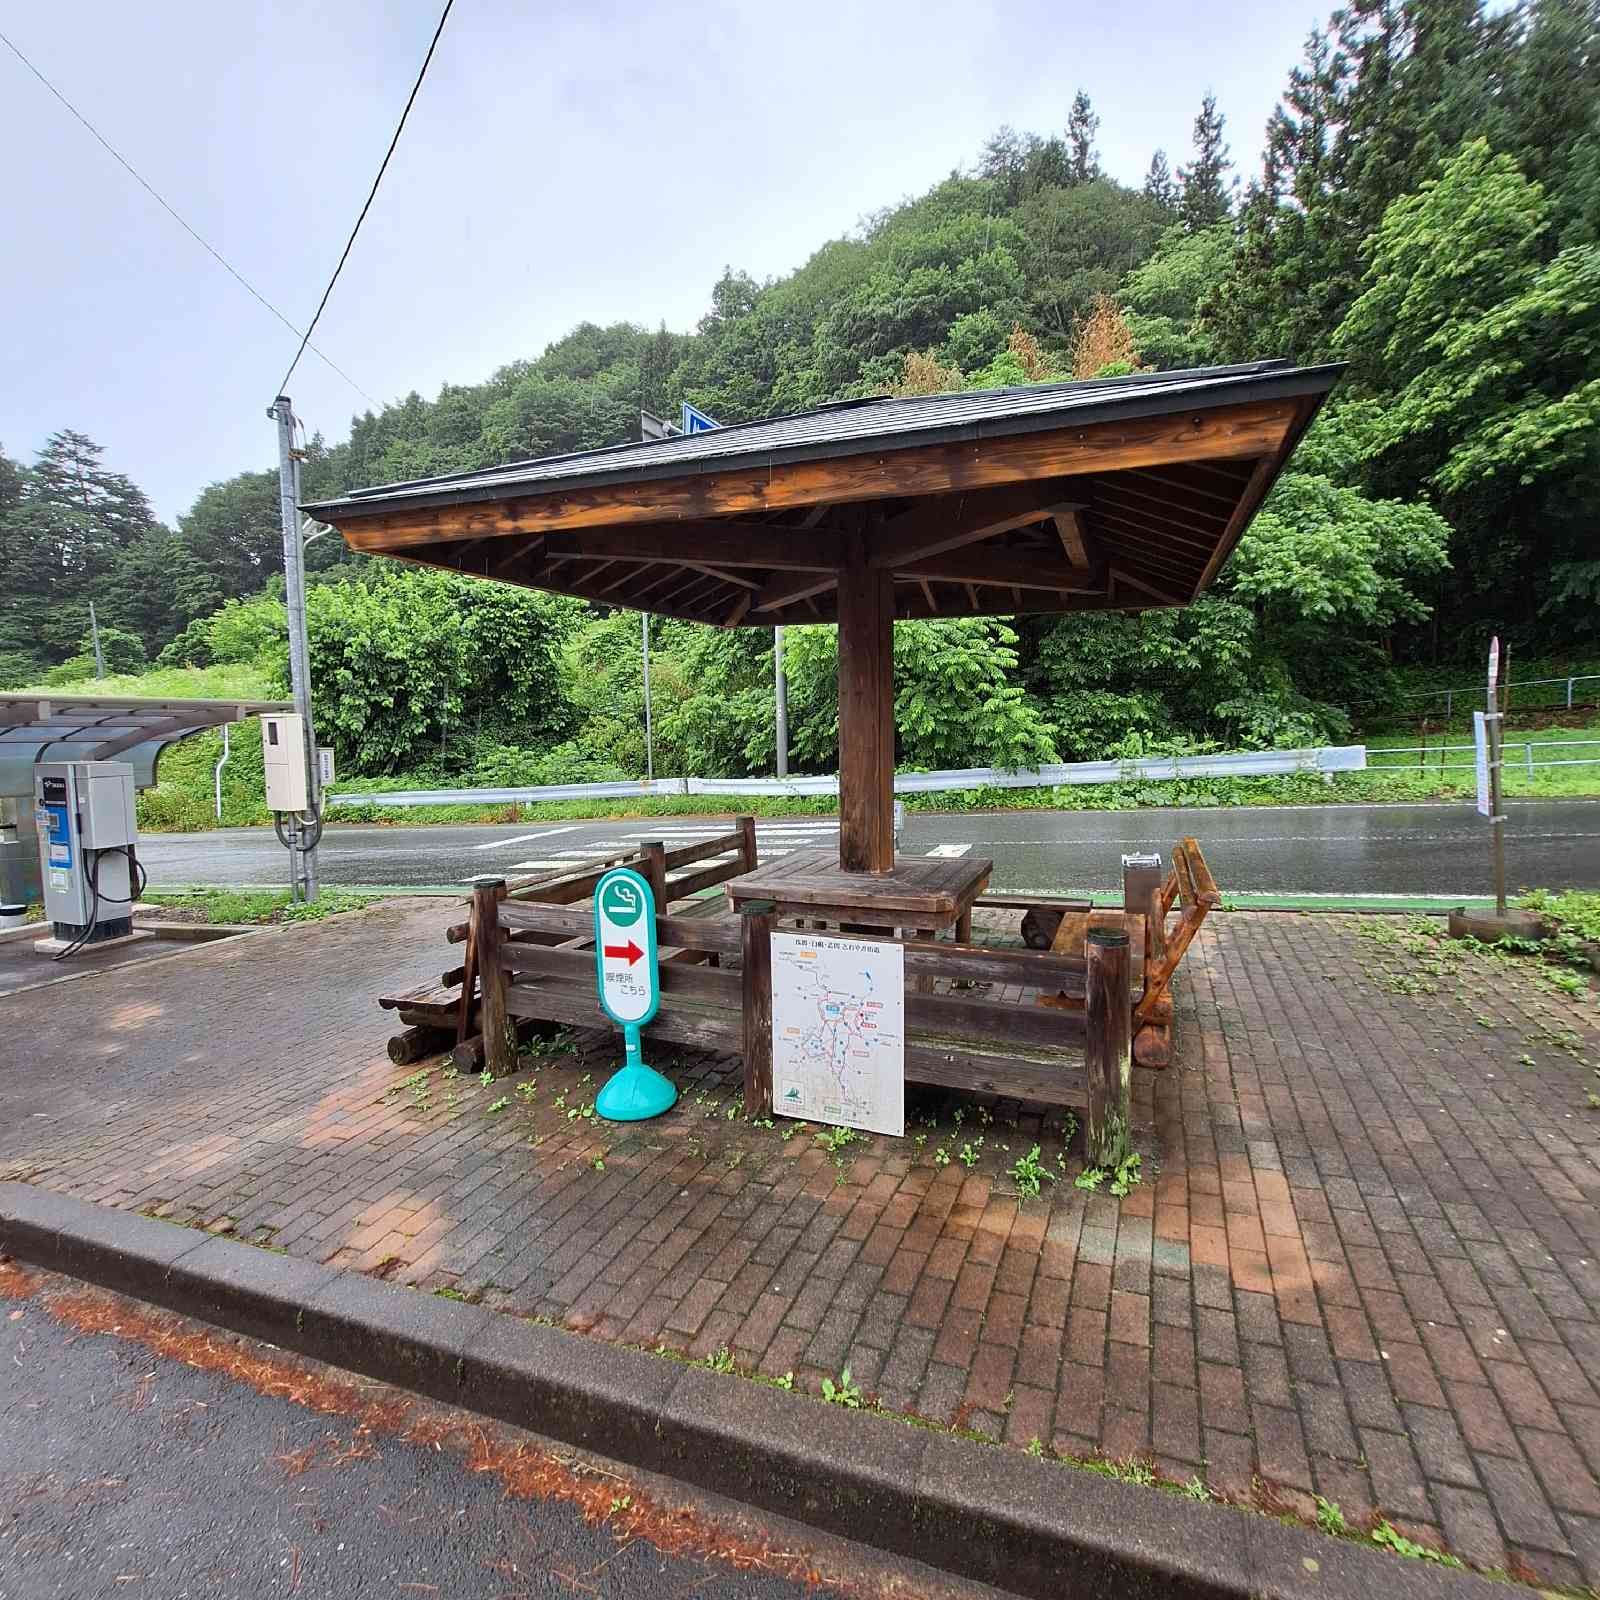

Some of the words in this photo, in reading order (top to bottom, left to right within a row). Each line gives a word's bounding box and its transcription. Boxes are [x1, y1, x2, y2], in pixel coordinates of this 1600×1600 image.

[606, 972, 633, 984] 喫煙所
[621, 985, 646, 996] こちら
